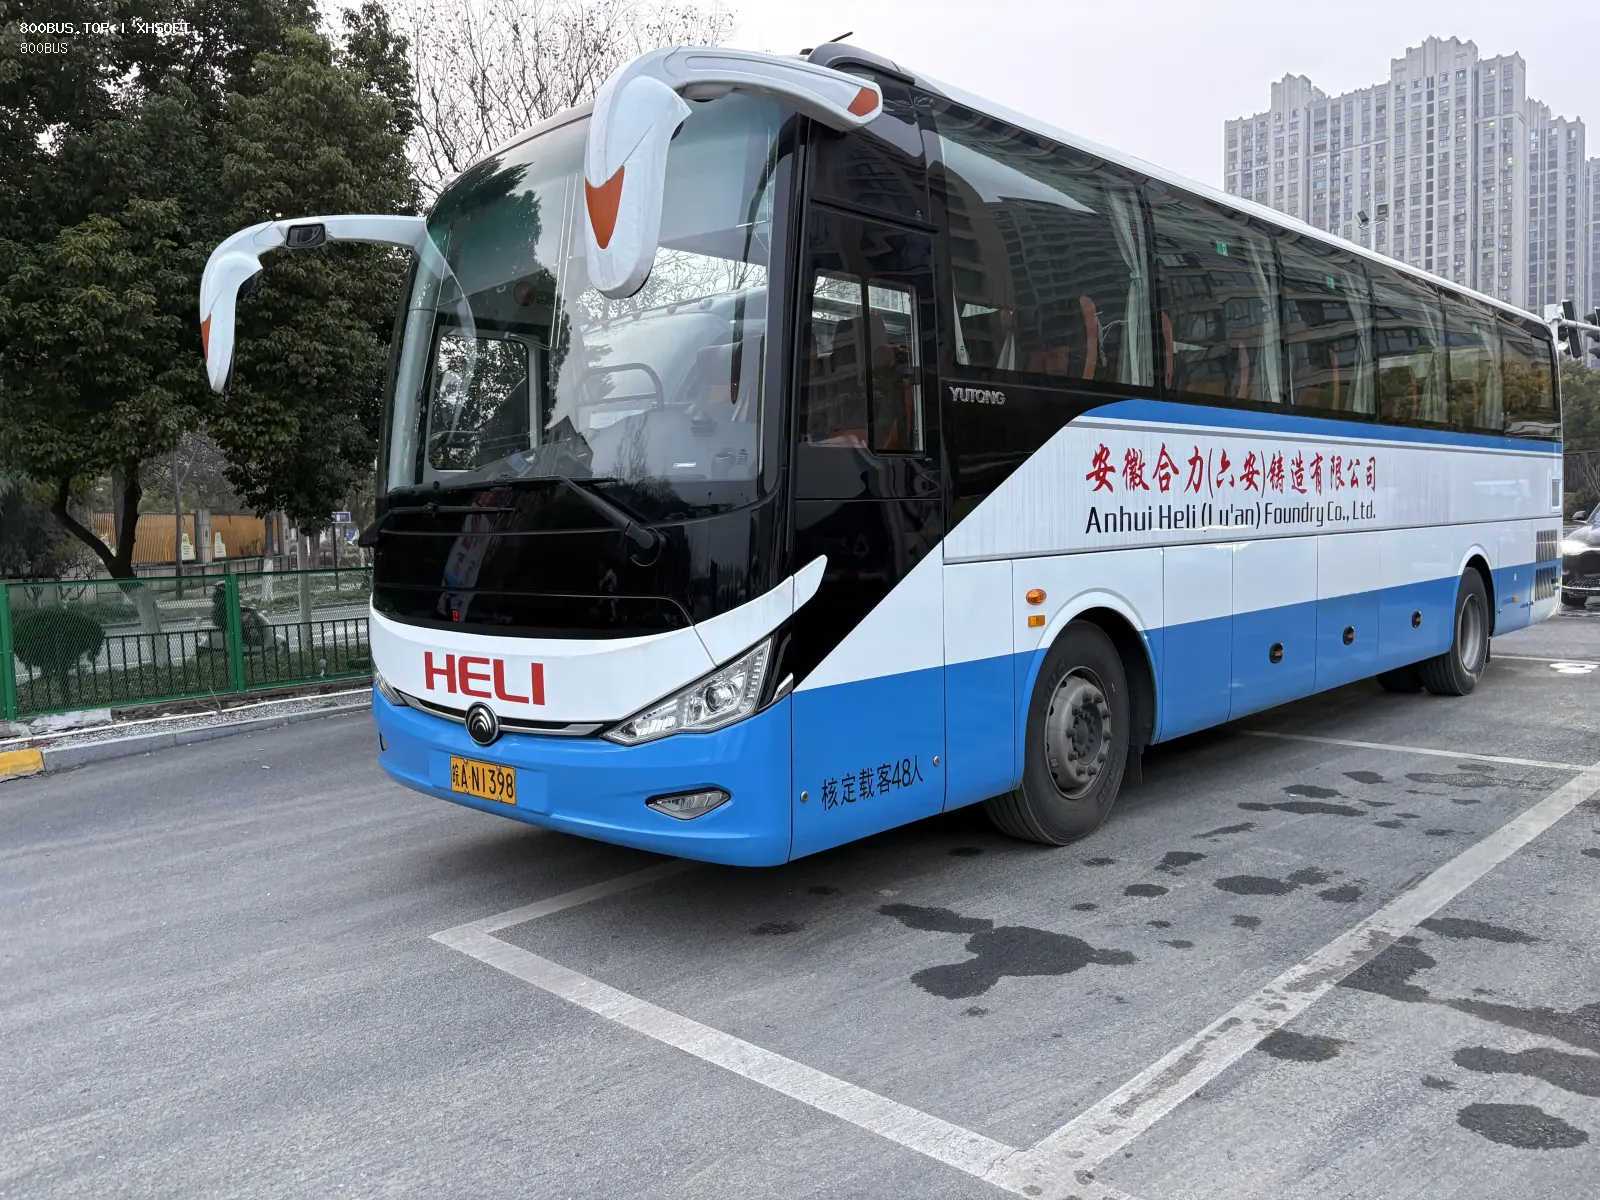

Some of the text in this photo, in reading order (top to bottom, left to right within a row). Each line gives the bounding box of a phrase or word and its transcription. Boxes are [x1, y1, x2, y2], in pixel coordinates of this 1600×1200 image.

[948, 386, 1006, 405] YUTONG
[1085, 505, 1152, 534] Anhui
[1159, 504, 1196, 530] Heli
[1264, 502, 1324, 527] Foundry
[1327, 501, 1350, 523] Co.,
[1352, 500, 1376, 520] Ltd.
[424, 651, 546, 706] HELI
[821, 754, 924, 811] 核定载客48人
